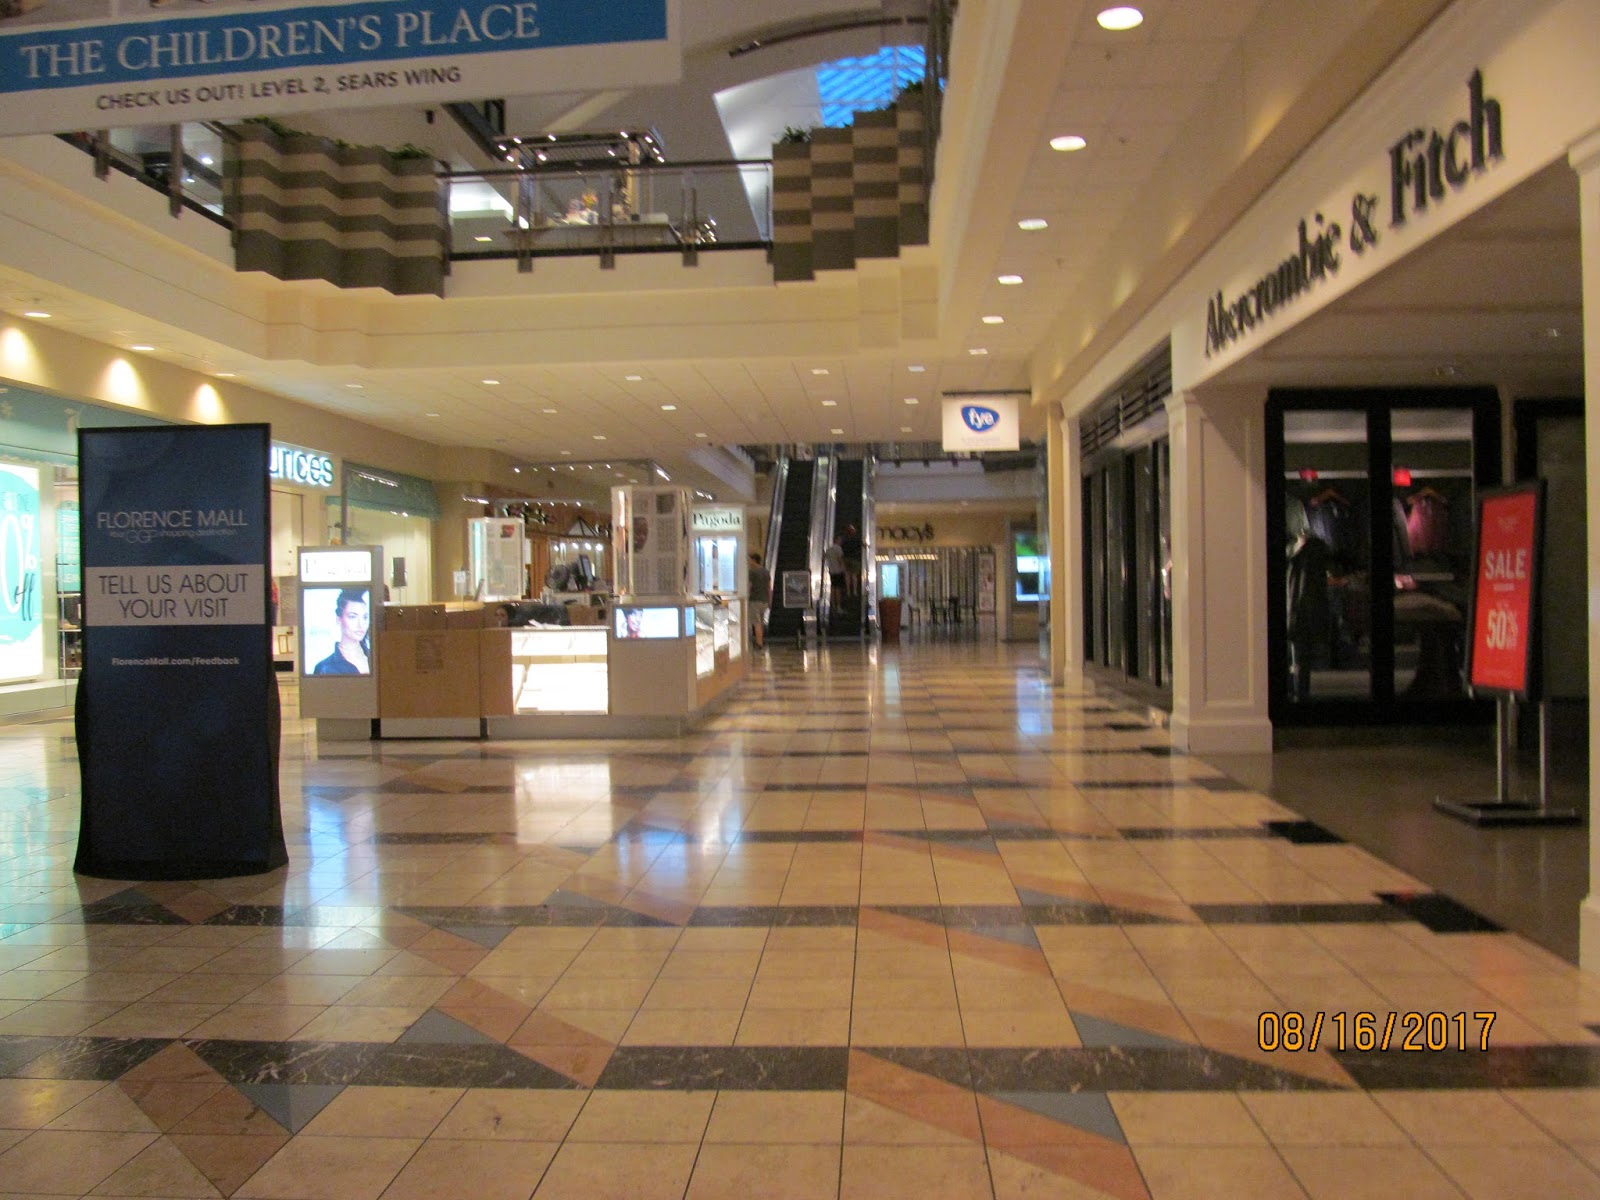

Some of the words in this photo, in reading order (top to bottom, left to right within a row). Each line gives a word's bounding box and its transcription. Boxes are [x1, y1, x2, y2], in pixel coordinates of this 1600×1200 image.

[20, 39, 106, 78] THE
[116, 14, 382, 71] CHILDREN'S
[395, 2, 540, 48] PLACE
[96, 92, 160, 110] CHECK
[166, 88, 192, 105] US
[196, 84, 244, 103] OUT!
[250, 78, 308, 98] LEVEL
[313, 76, 331, 95] 2,
[337, 70, 400, 92] SEARS
[403, 65, 462, 86] WING
[1349, 192, 1379, 256] &
[1388, 66, 1505, 230] Fitch
[97, 510, 193, 529] FLORENCE
[198, 509, 249, 527] MALL
[1485, 548, 1526, 580] SALE
[99, 574, 138, 595] TELL
[147, 574, 172, 594] US
[180, 573, 249, 594] ABOUT
[119, 599, 177, 619] YOUR
[185, 598, 229, 618] VISIT
